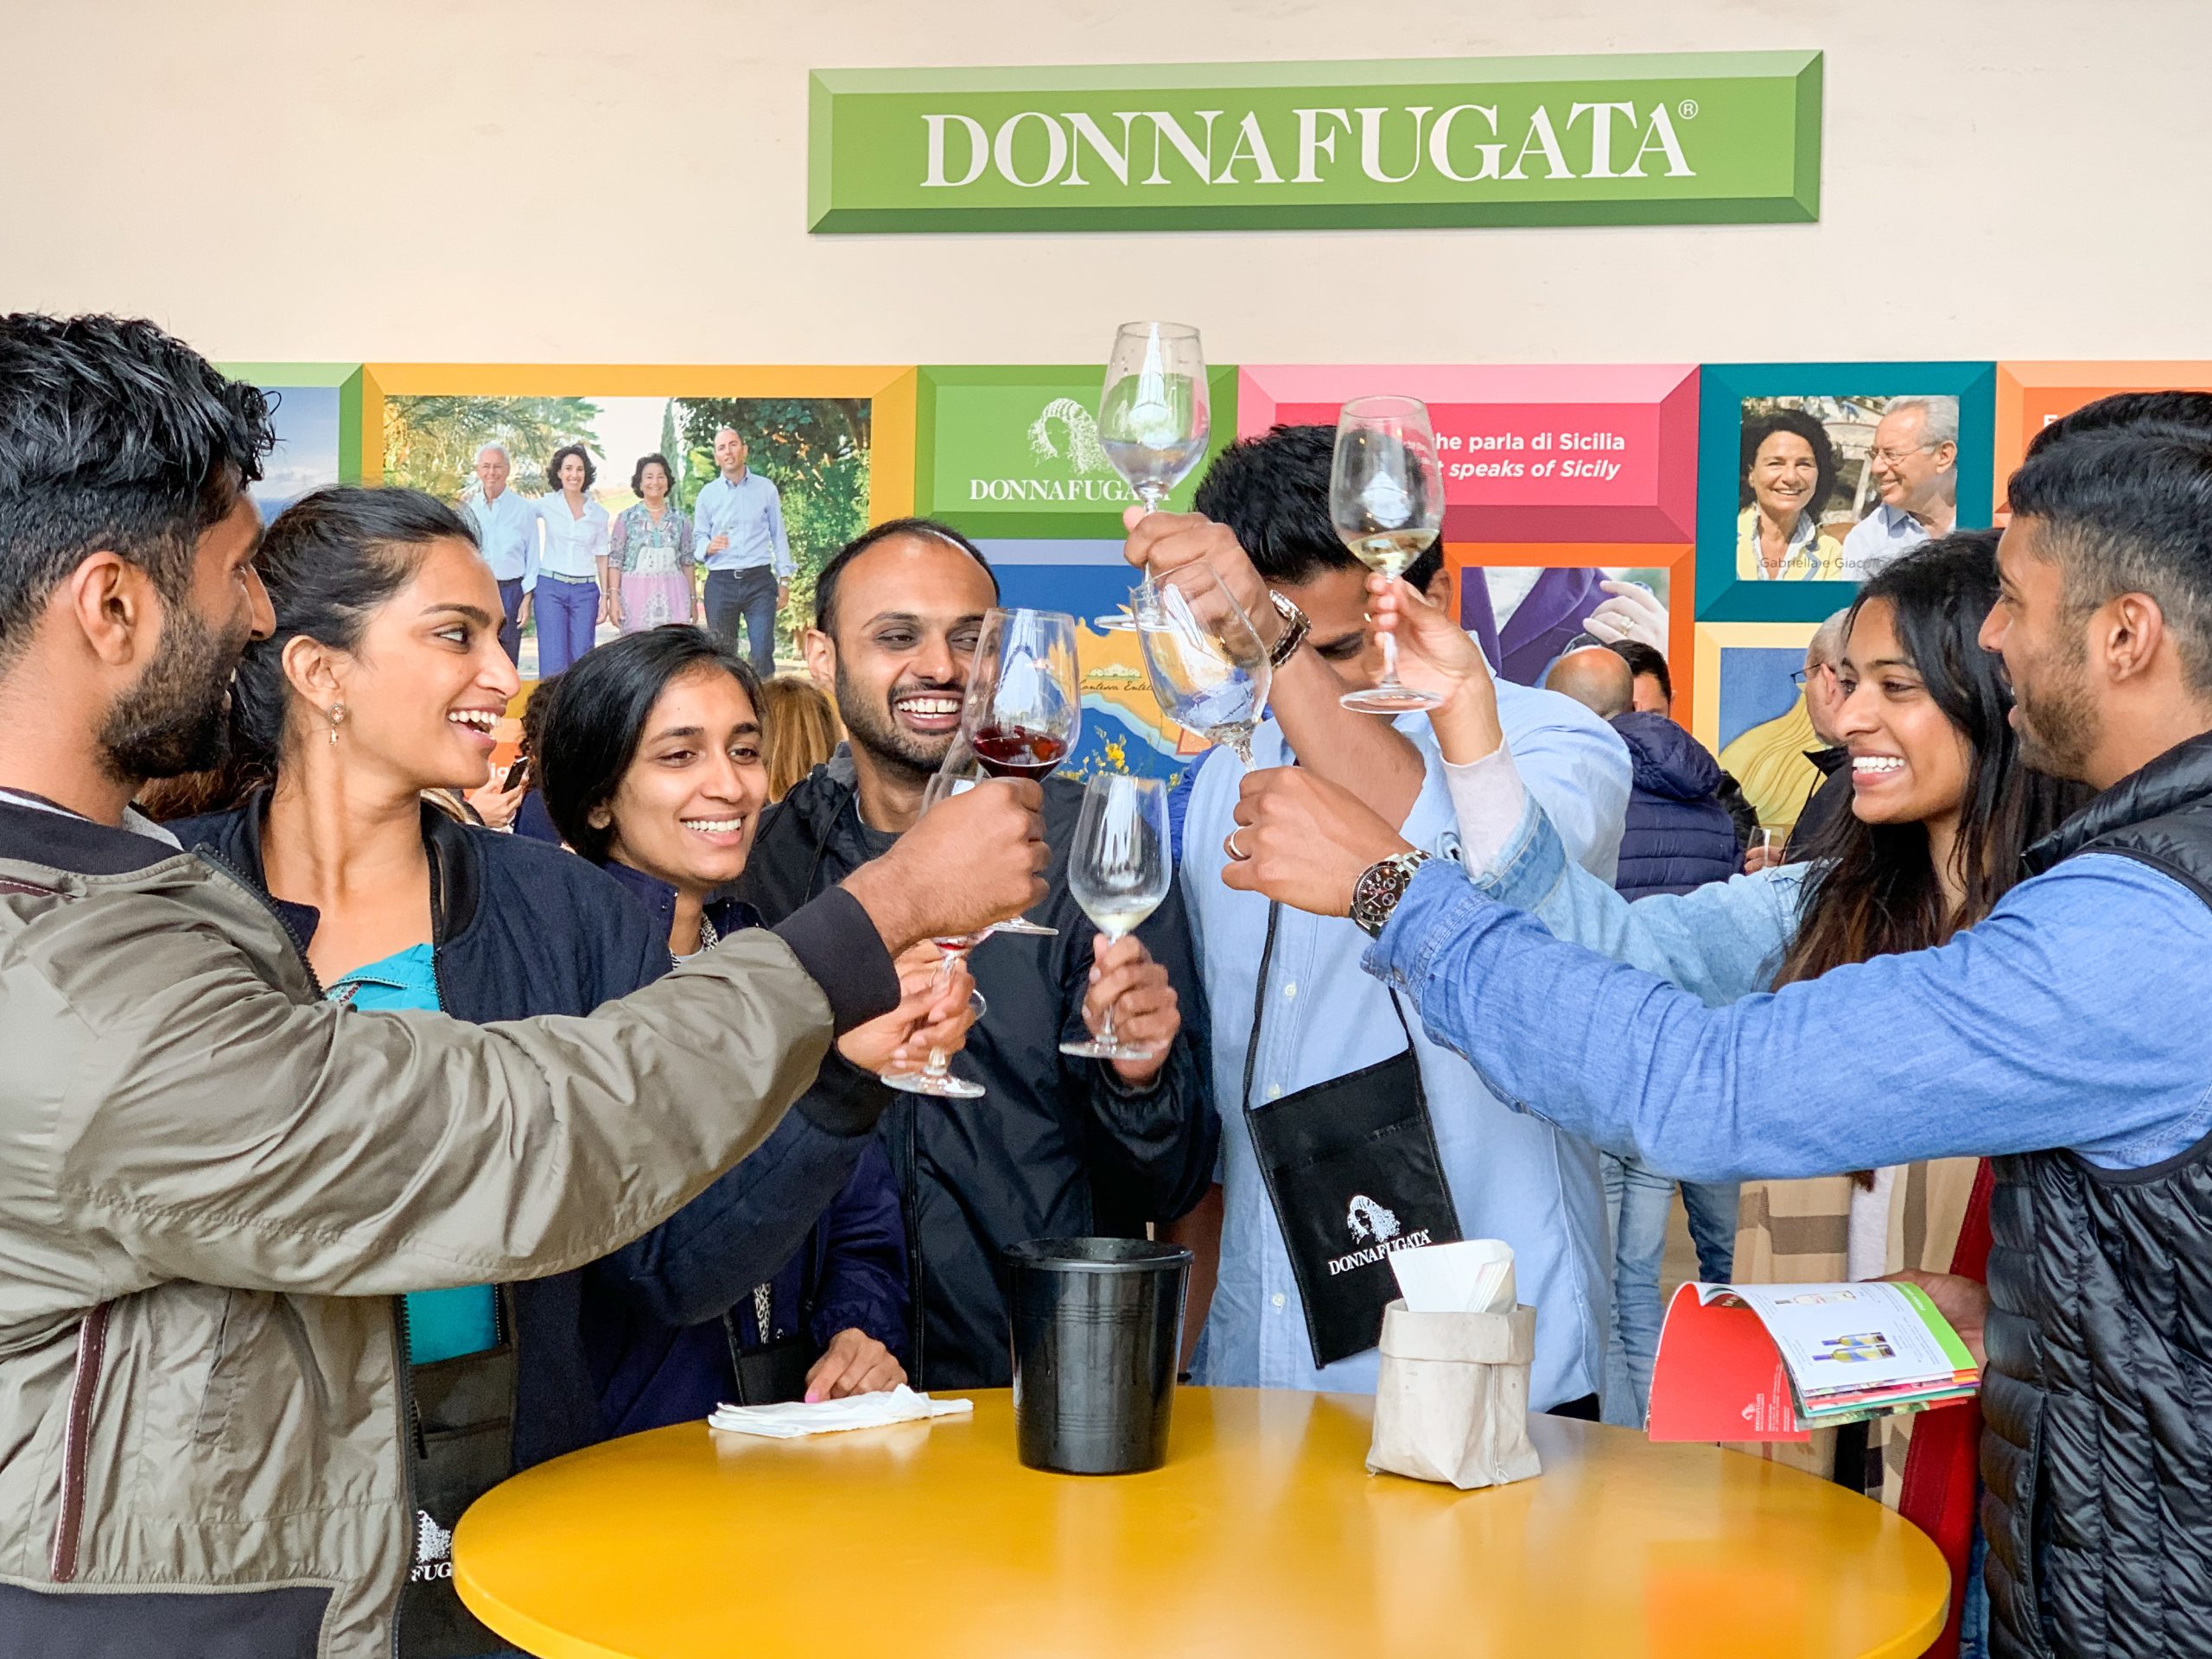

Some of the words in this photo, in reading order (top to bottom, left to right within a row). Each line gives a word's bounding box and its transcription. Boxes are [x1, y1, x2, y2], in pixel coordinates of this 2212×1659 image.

[1433, 432, 1463, 450] he
[1469, 432, 1524, 454] parla
[1531, 432, 1552, 450] di
[1559, 432, 1625, 450] Sicilia
[1449, 459, 1525, 480] speaks
[1530, 459, 1557, 478] of
[1560, 459, 1622, 481] Sicily
[969, 479, 1171, 501] DONNAFUGA
[1760, 556, 1818, 569] Gabriella
[1822, 560, 1831, 569] e
[1328, 1229, 1433, 1276] DONNAFUGATA
